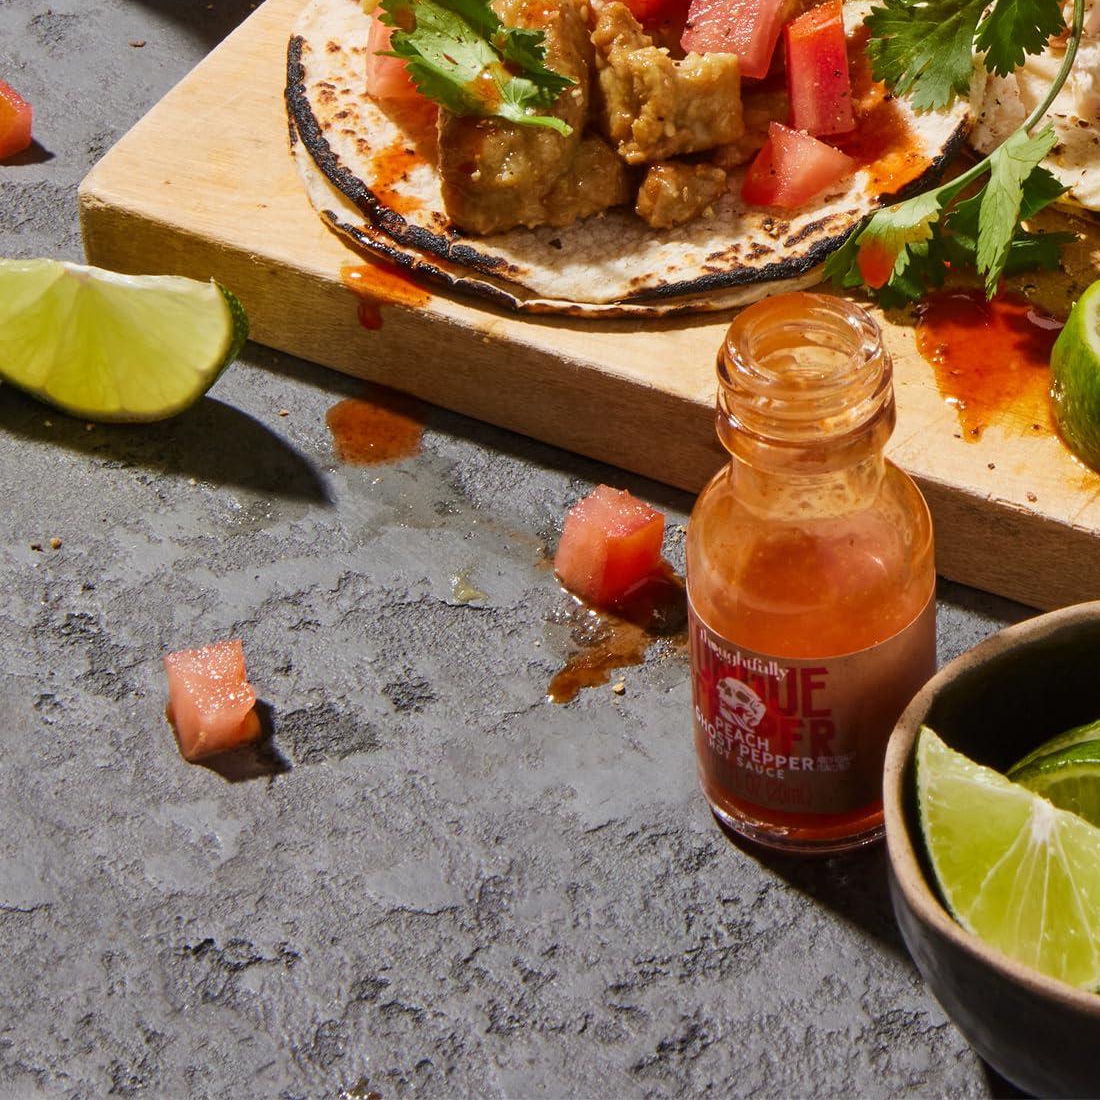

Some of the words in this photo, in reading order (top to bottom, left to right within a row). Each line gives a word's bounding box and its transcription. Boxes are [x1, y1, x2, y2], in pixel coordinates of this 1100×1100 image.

[695, 705, 734, 751] GHOST
[740, 743, 814, 772] PEPPER
[716, 716, 769, 751] PEACH
[709, 737, 730, 760] HOT
[736, 757, 785, 779] SAUCE
